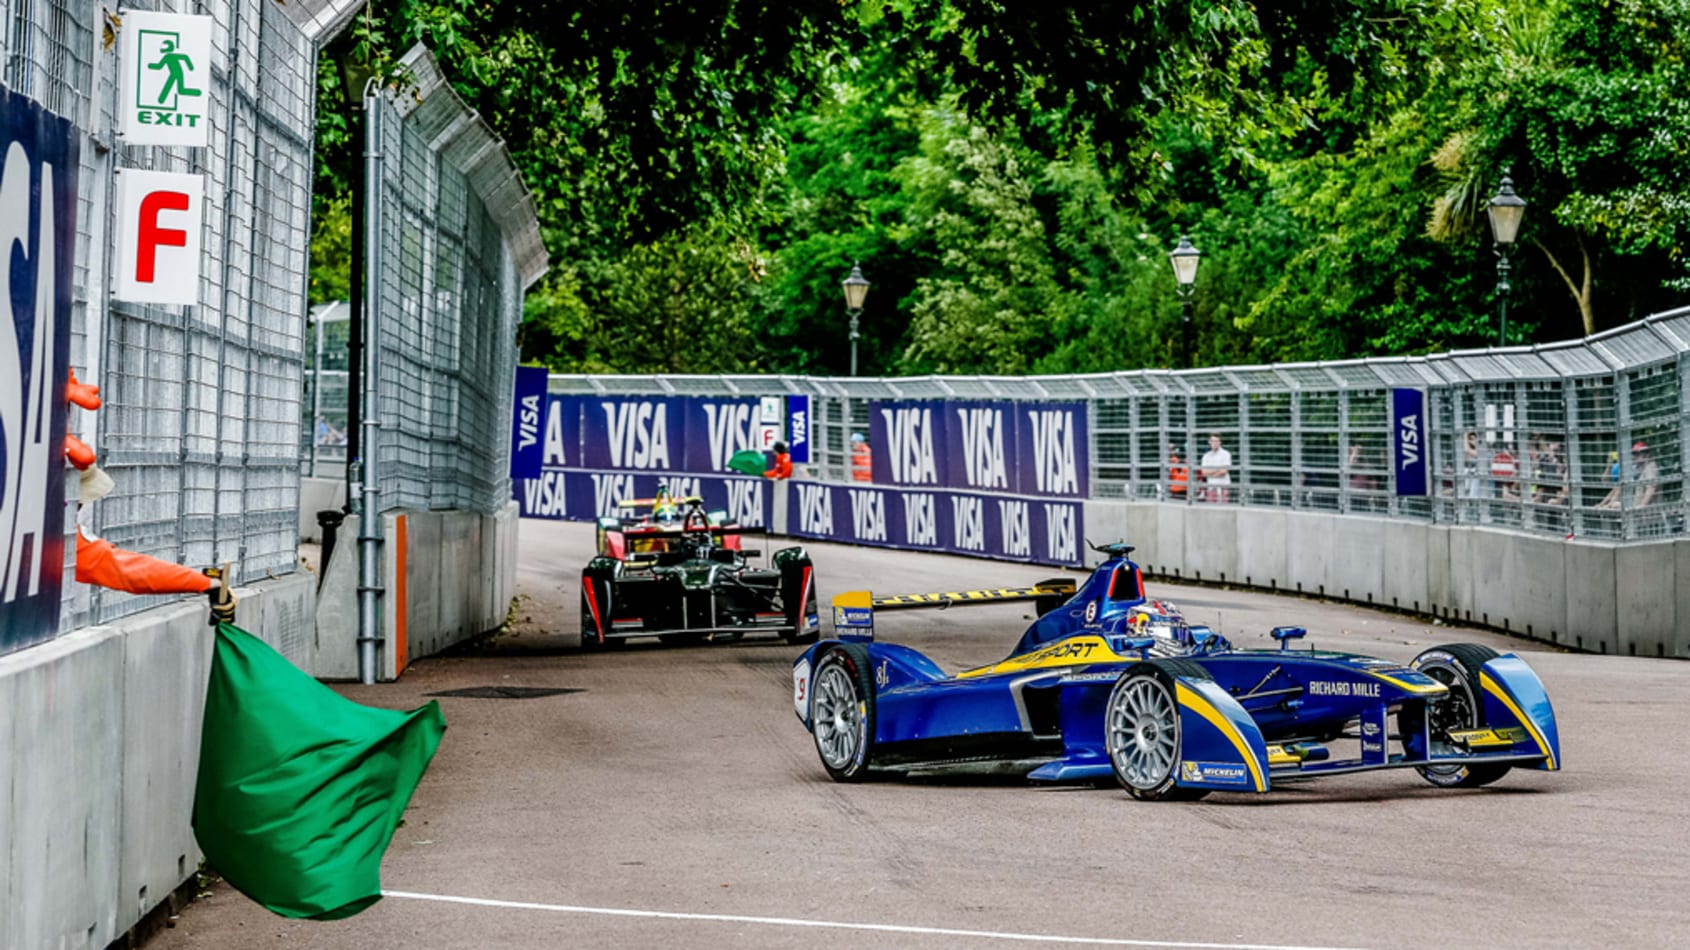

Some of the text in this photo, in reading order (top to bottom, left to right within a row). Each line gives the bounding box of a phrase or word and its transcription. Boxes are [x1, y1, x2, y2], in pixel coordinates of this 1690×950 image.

[137, 111, 201, 128] EXIT
[135, 190, 190, 284] F
[0, 140, 55, 603] SA
[518, 395, 540, 452] VISA
[602, 402, 670, 469] VISA
[764, 429, 774, 446] F
[792, 410, 806, 447] VISA
[881, 408, 937, 484] VISA
[957, 408, 1008, 489] VISA
[1401, 414, 1419, 471] VISA
[1028, 409, 1079, 494] VISA
[524, 472, 567, 516] VISA
[590, 474, 635, 519] VISA
[724, 480, 764, 527] VISA
[796, 484, 834, 535] VISA
[848, 489, 888, 541] VISA
[902, 493, 937, 545] VISA
[951, 496, 985, 550] VISA
[998, 500, 1031, 555] VISA
[1044, 503, 1077, 561] VISA
[1309, 681, 1381, 697] RICHARD MILLE
[1203, 767, 1244, 777] MICHELIN
